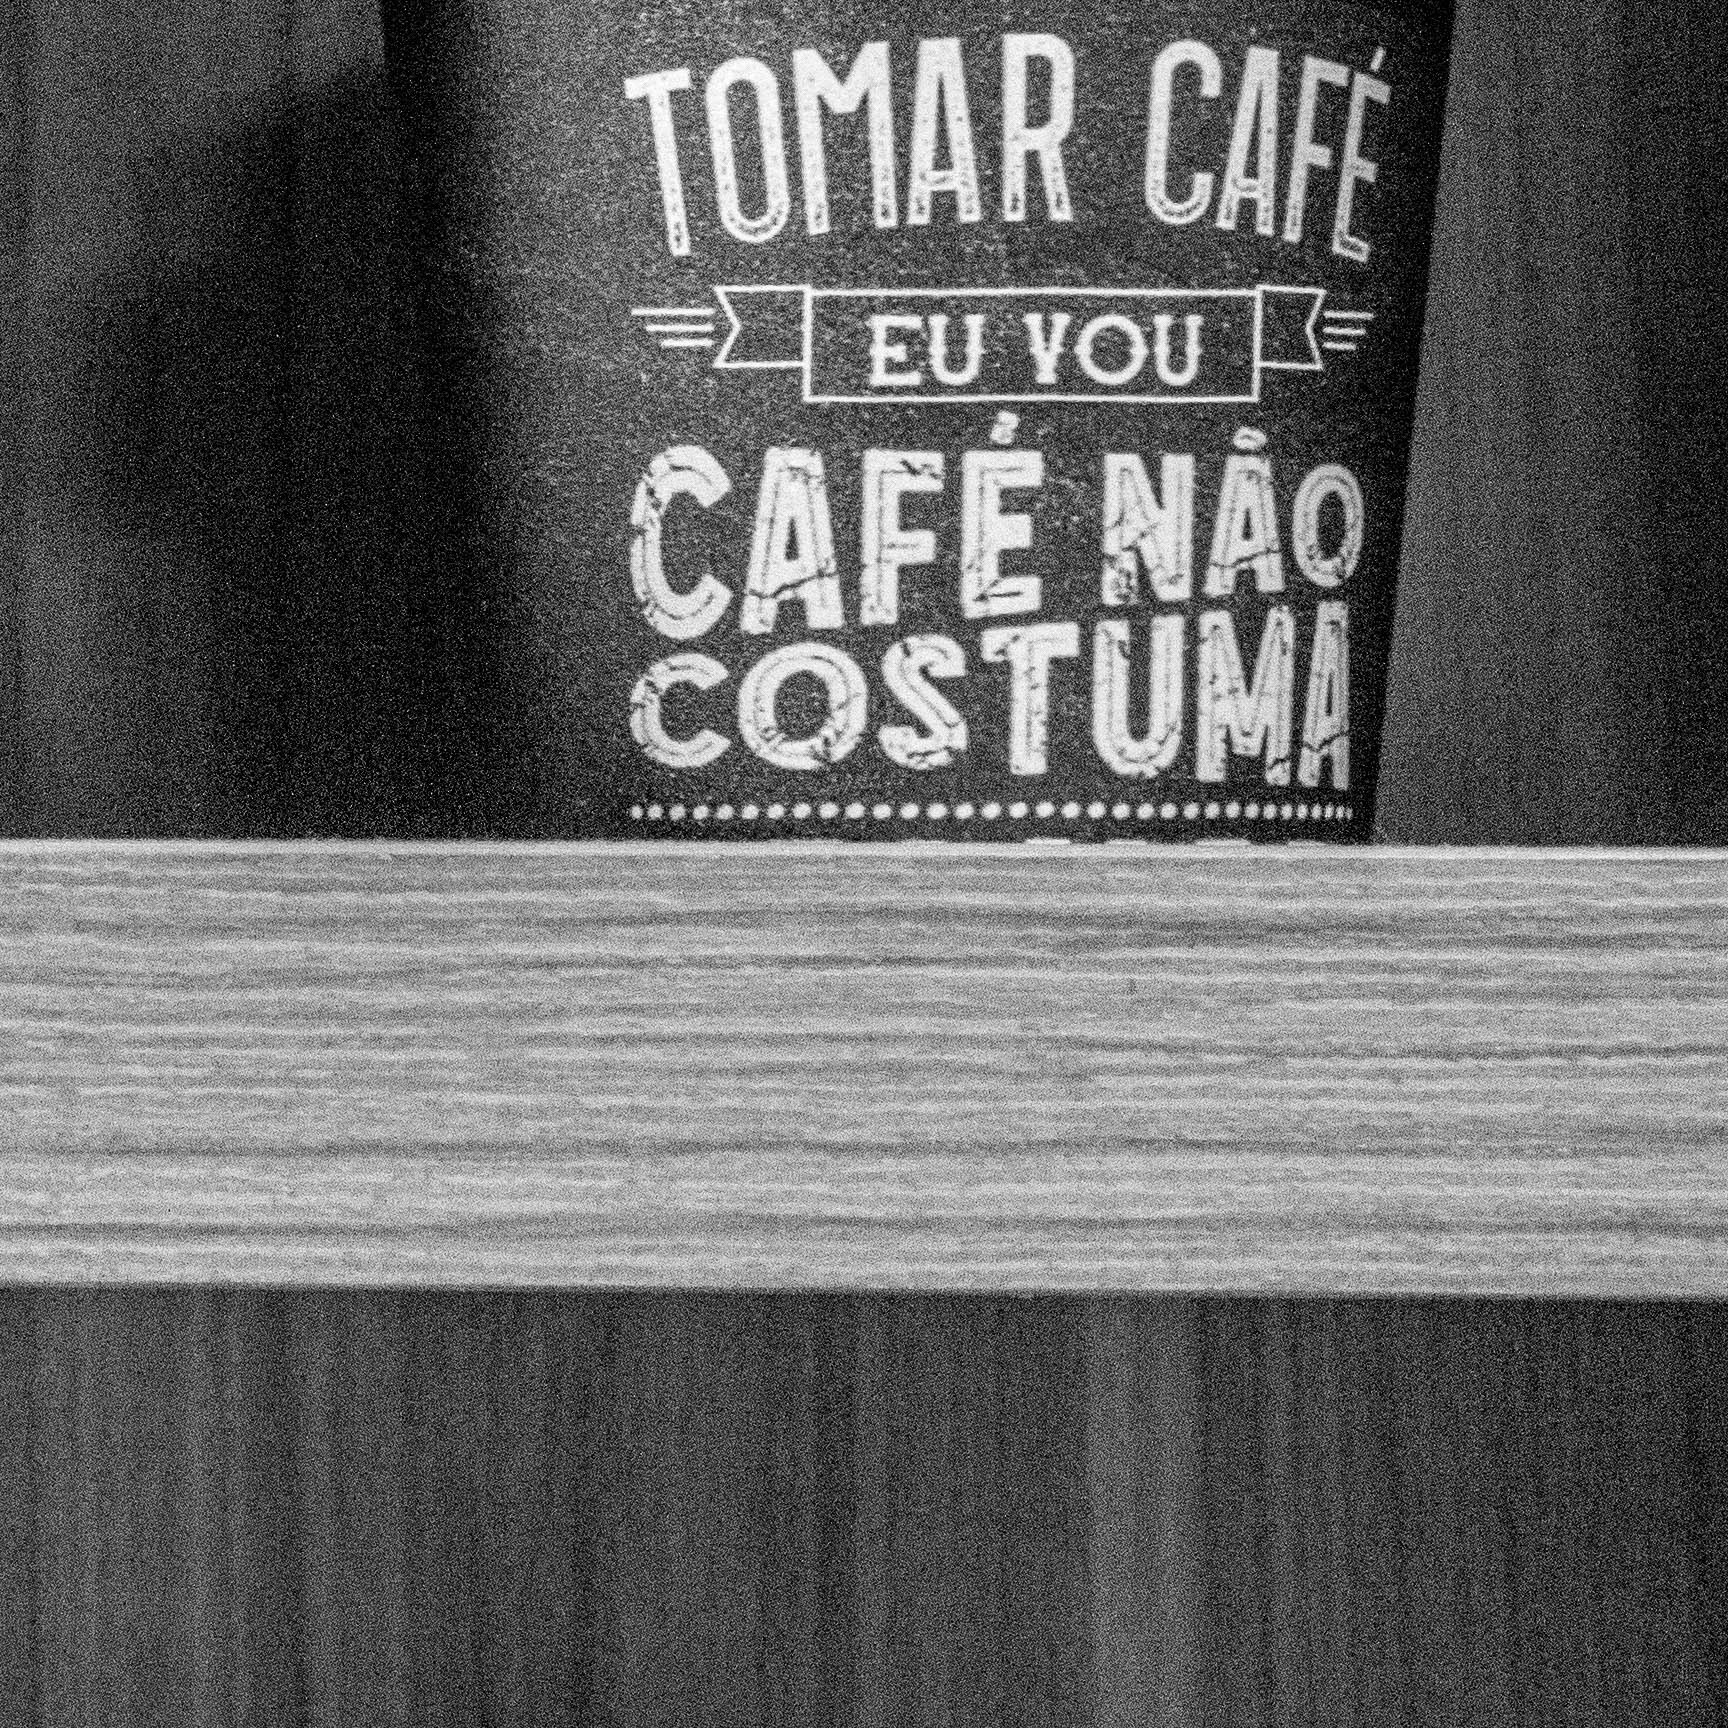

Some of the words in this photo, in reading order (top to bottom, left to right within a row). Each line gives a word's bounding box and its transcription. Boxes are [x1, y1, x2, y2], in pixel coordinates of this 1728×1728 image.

[623, 32, 1076, 258] TOMAR
[1144, 39, 1391, 262] CAFÉ
[867, 312, 987, 387] EU
[1022, 312, 1204, 387] VOU
[630, 410, 1046, 641] CAFÉ
[1101, 425, 1366, 608] NÃO
[629, 601, 1349, 790] COSTUMA
